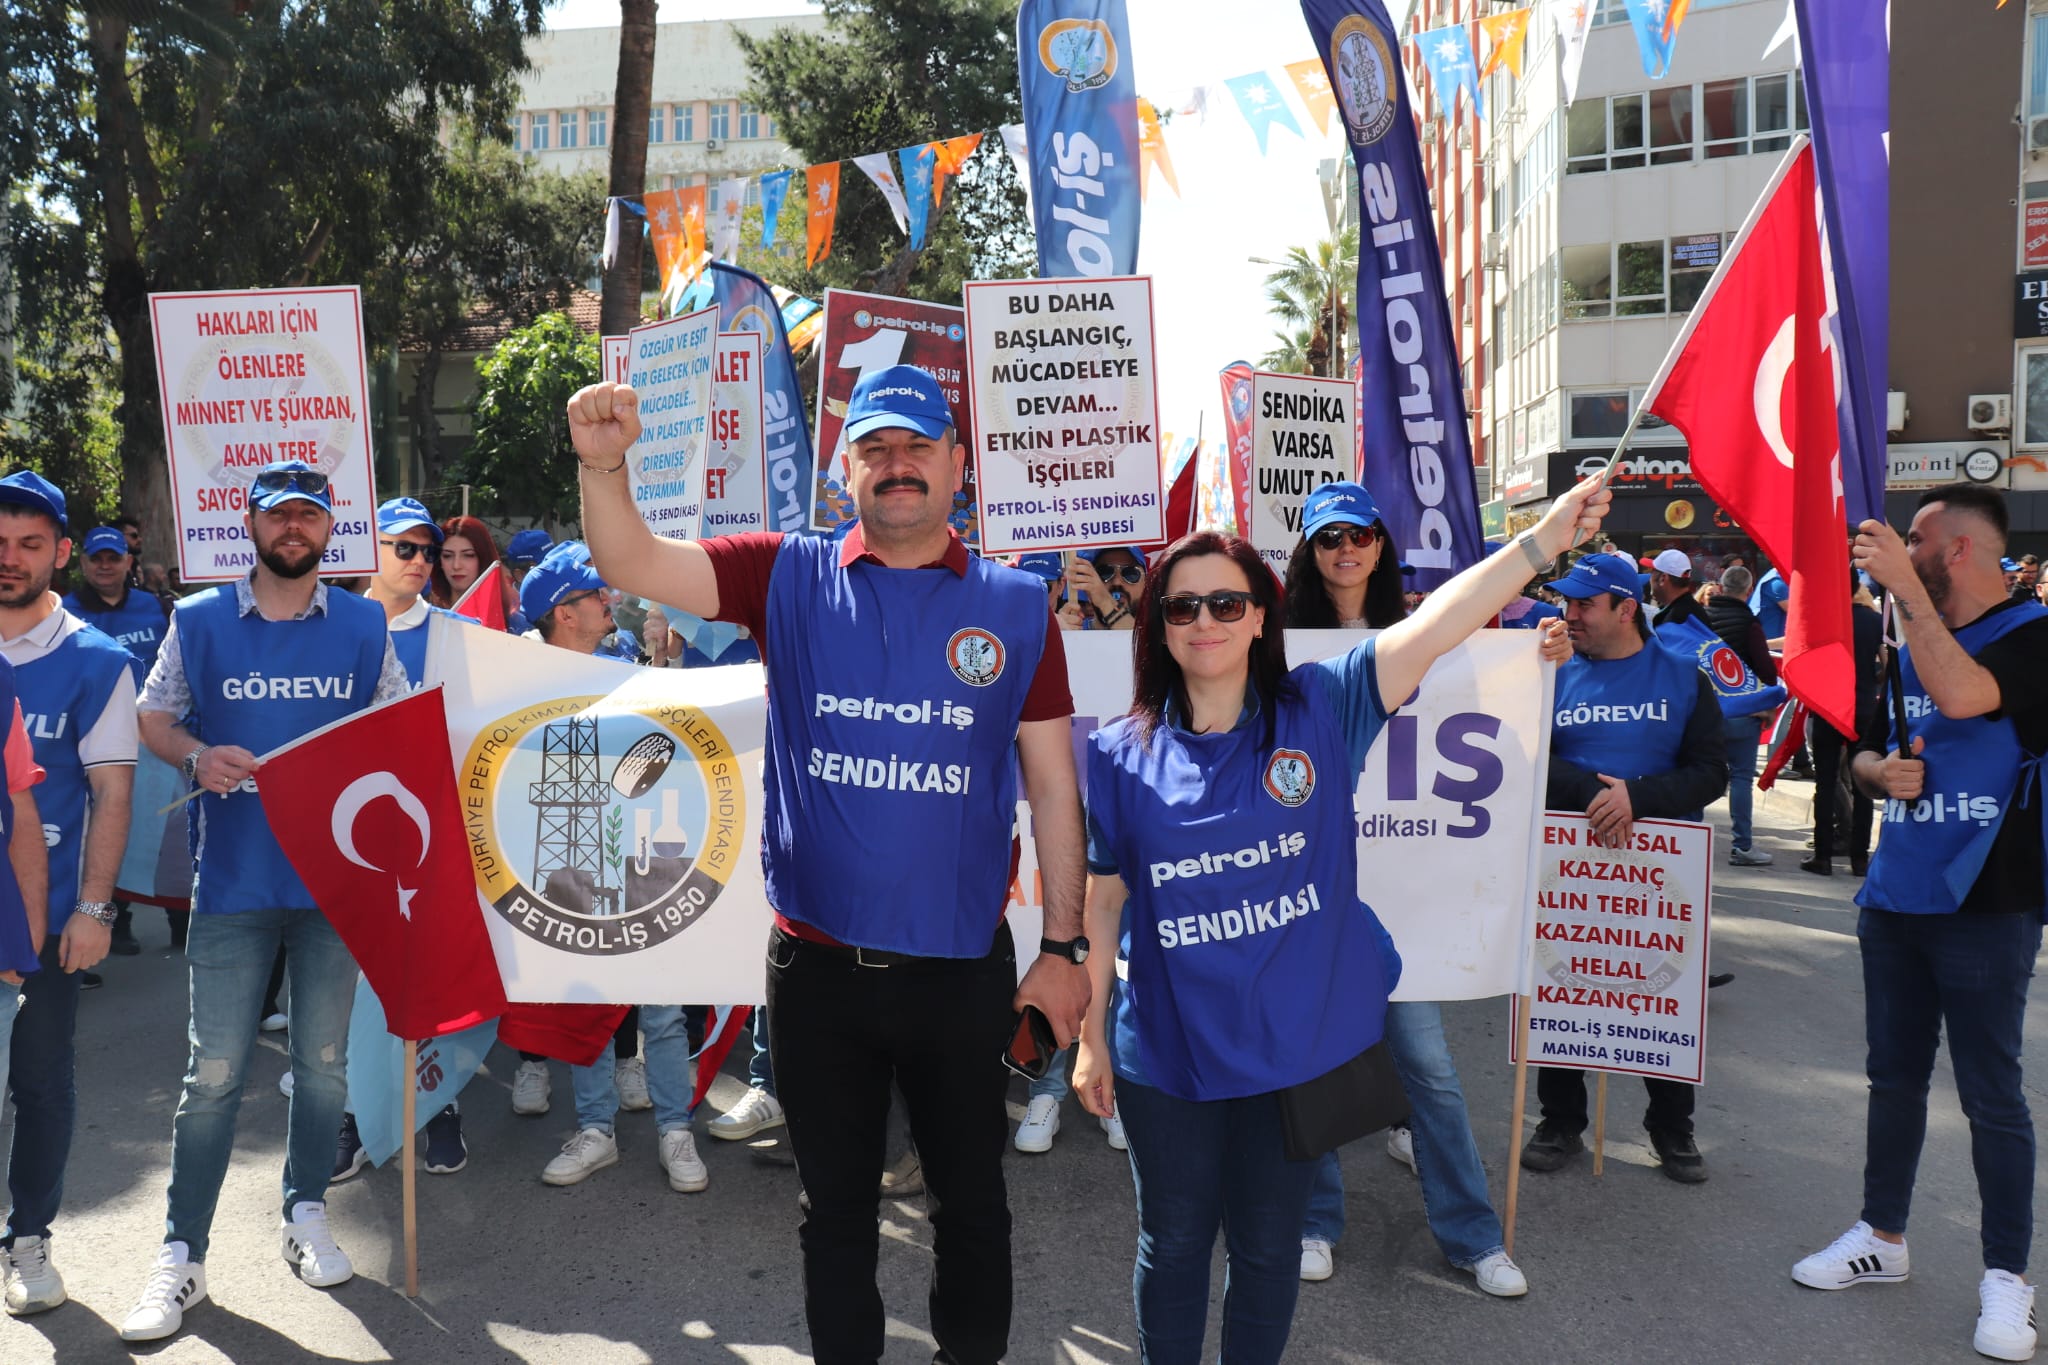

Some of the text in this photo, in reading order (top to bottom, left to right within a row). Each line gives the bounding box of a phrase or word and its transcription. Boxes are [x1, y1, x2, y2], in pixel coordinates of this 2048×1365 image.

[1051, 131, 1114, 277] ol-iş
[1008, 292, 1114, 315] BU DAHA
[196, 302, 319, 340] HAKLARI İÇİN
[873, 314, 946, 337] petrol-iş
[640, 323, 709, 359] ÖZGÜR VE EŞİT
[994, 325, 1133, 354] BAŞLANGIÇ,
[218, 349, 306, 381] ÖLENLERE
[631, 368, 649, 388] BİR
[650, 361, 689, 385] GELECEK
[691, 353, 710, 378] İÇİN
[713, 350, 750, 384] LET
[991, 357, 1139, 384] MÜCADELEYE
[640, 390, 697, 415] MÜCADELE...
[867, 387, 927, 402] petrol-iş
[1016, 394, 1118, 416] DEVAM...
[1262, 387, 1346, 423] SENDİKA
[176, 390, 356, 429] MİNNET VE ŞÜKRAN,
[637, 423, 655, 445] KİN
[987, 425, 1053, 452] ETKİN
[1062, 420, 1152, 450] PLASTİK
[1272, 430, 1335, 460] VARSA
[223, 440, 319, 467] AKAN TERE
[1894, 455, 1952, 476] point
[1975, 457, 1990, 465] Car
[1027, 454, 1115, 488] İŞÇİLERİ
[1259, 467, 1315, 496] UMUT
[1968, 464, 1996, 473] Rental
[659, 503, 699, 521] SENDİKASI
[706, 511, 761, 525] NDİKASI
[987, 491, 1156, 517] PETROL-İŞ SENDİKASI
[1314, 494, 1356, 513] petrol-iş
[186, 526, 249, 541] PETROL
[1012, 516, 1135, 541] MANİSA ŞUBESİ
[213, 544, 346, 567] MAN ESİ
[116, 627, 156, 647] EVLİ
[222, 672, 354, 700] GÖREVLİ
[815, 692, 974, 731] petrol-iş
[1556, 698, 1668, 728] GÖREVLİ
[807, 747, 971, 795] SENDİKASI
[467, 701, 581, 884] TÜRKİYE PETROL KİMYA
[711, 762, 734, 871] SENDİKASI
[1355, 812, 1437, 840] ndikası
[1544, 826, 1683, 855] EN KTSAL
[1149, 829, 1307, 888] petrol-iş
[1559, 860, 1665, 891] KAZANÇ
[507, 886, 706, 949] PETROL-İŞ 1950
[1157, 883, 1321, 949] SENDİKASI
[1597, 893, 1648, 917] TERİ
[1657, 895, 1693, 922] İLE
[1535, 922, 1684, 954] KAZANILAN
[1571, 956, 1647, 981] HELAL
[1537, 985, 1679, 1017] KAZANÇTIR
[1530, 1018, 1697, 1048] ETROL-İŞ SENDİKASI
[1542, 1041, 1671, 1067] MANİSA ŞUBESİ
